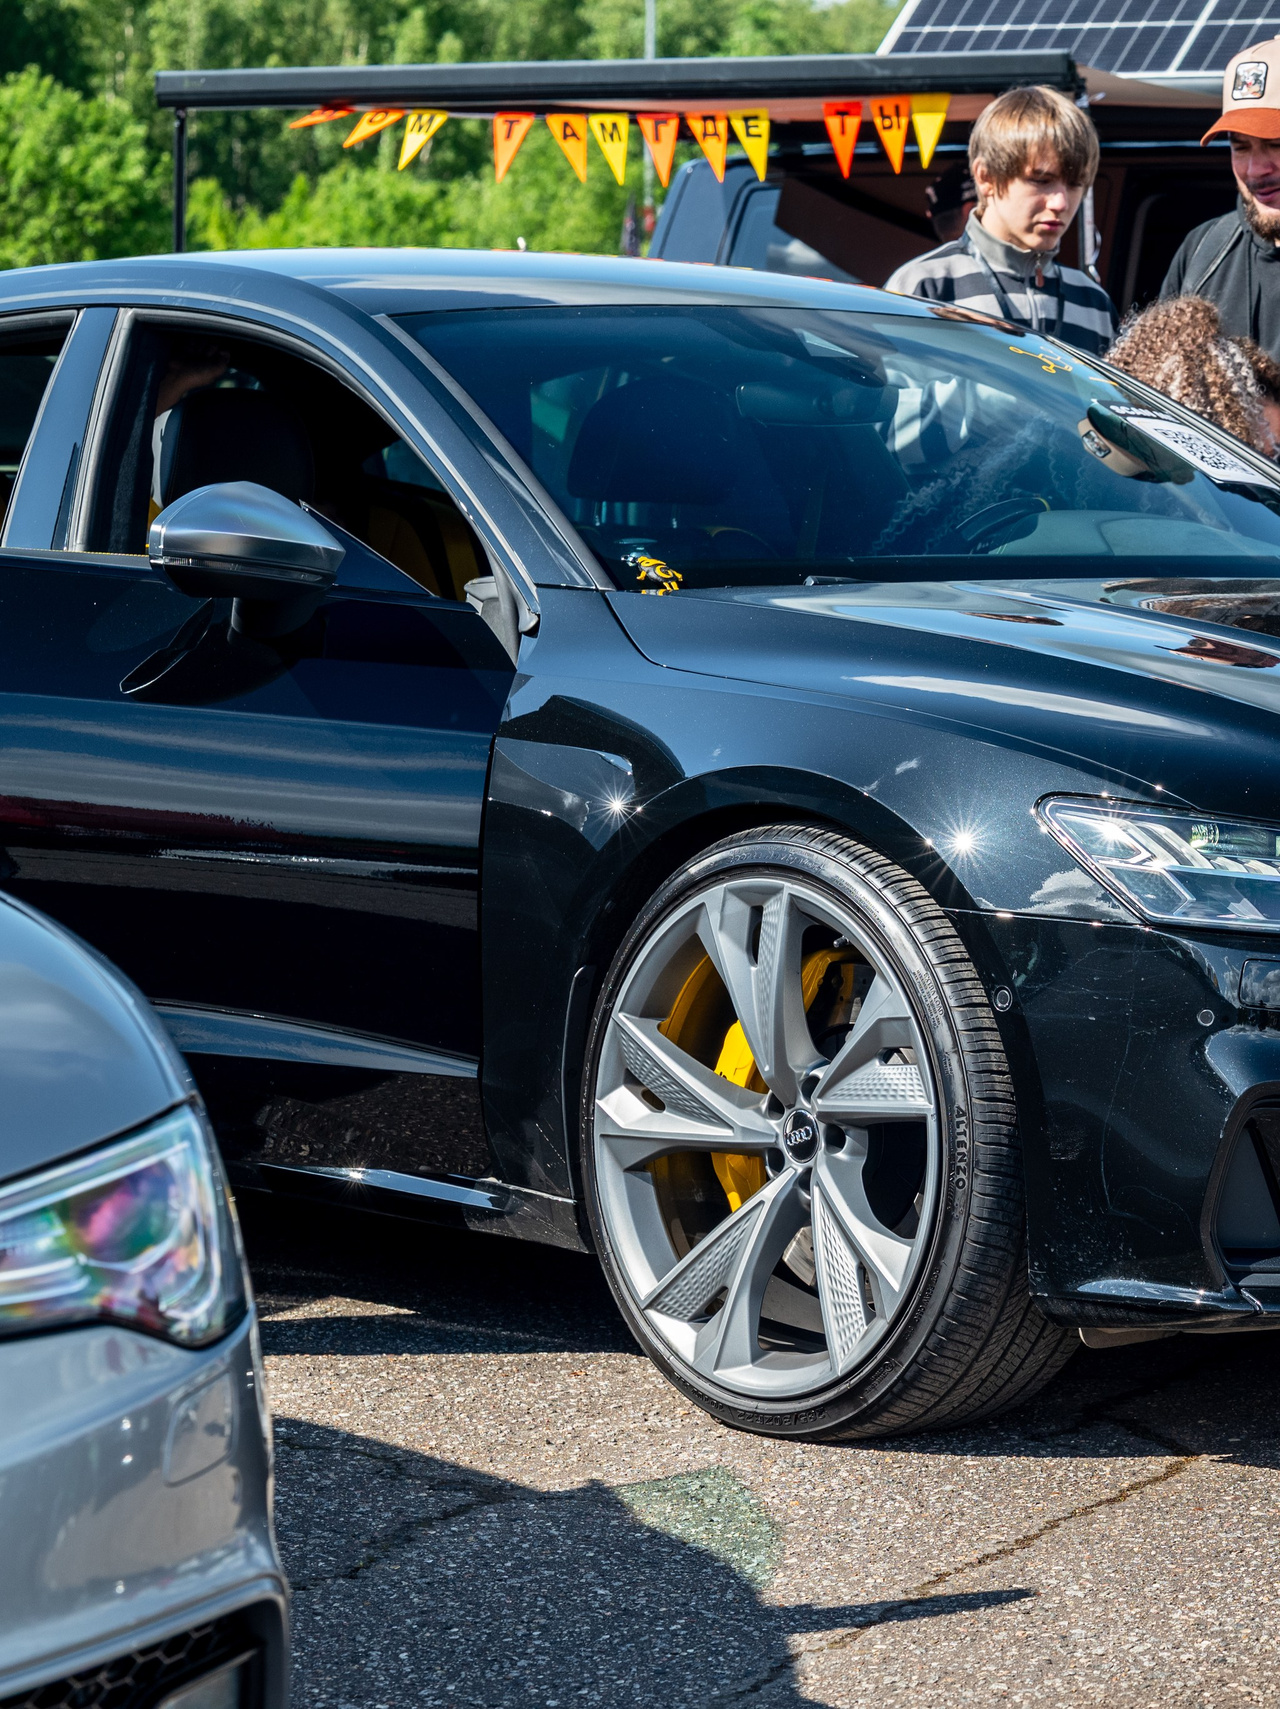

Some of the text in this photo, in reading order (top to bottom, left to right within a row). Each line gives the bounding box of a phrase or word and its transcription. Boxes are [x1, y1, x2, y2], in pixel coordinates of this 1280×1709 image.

[503, 118, 621, 142] ТАМ
[652, 115, 762, 142] ГДЕ
[836, 104, 901, 136] ТЫ
[954, 1105, 968, 1190] ALTENZO
